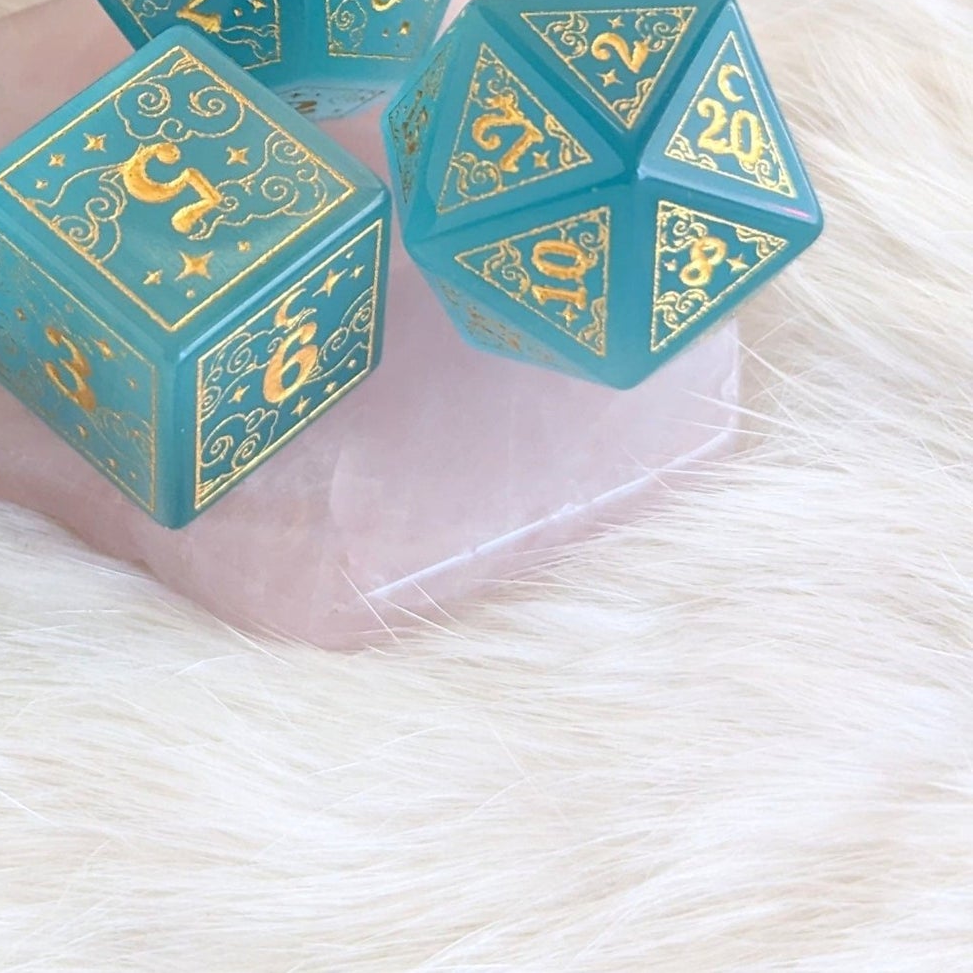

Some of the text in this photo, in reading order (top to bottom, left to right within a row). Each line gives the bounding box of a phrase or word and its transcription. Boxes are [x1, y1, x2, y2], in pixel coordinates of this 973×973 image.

[591, 31, 649, 74] 2
[697, 98, 763, 166] 20
[124, 142, 223, 234] 5
[531, 239, 589, 309] 10
[681, 236, 726, 287] 8
[44, 326, 96, 412] 3
[263, 323, 318, 404] 6
